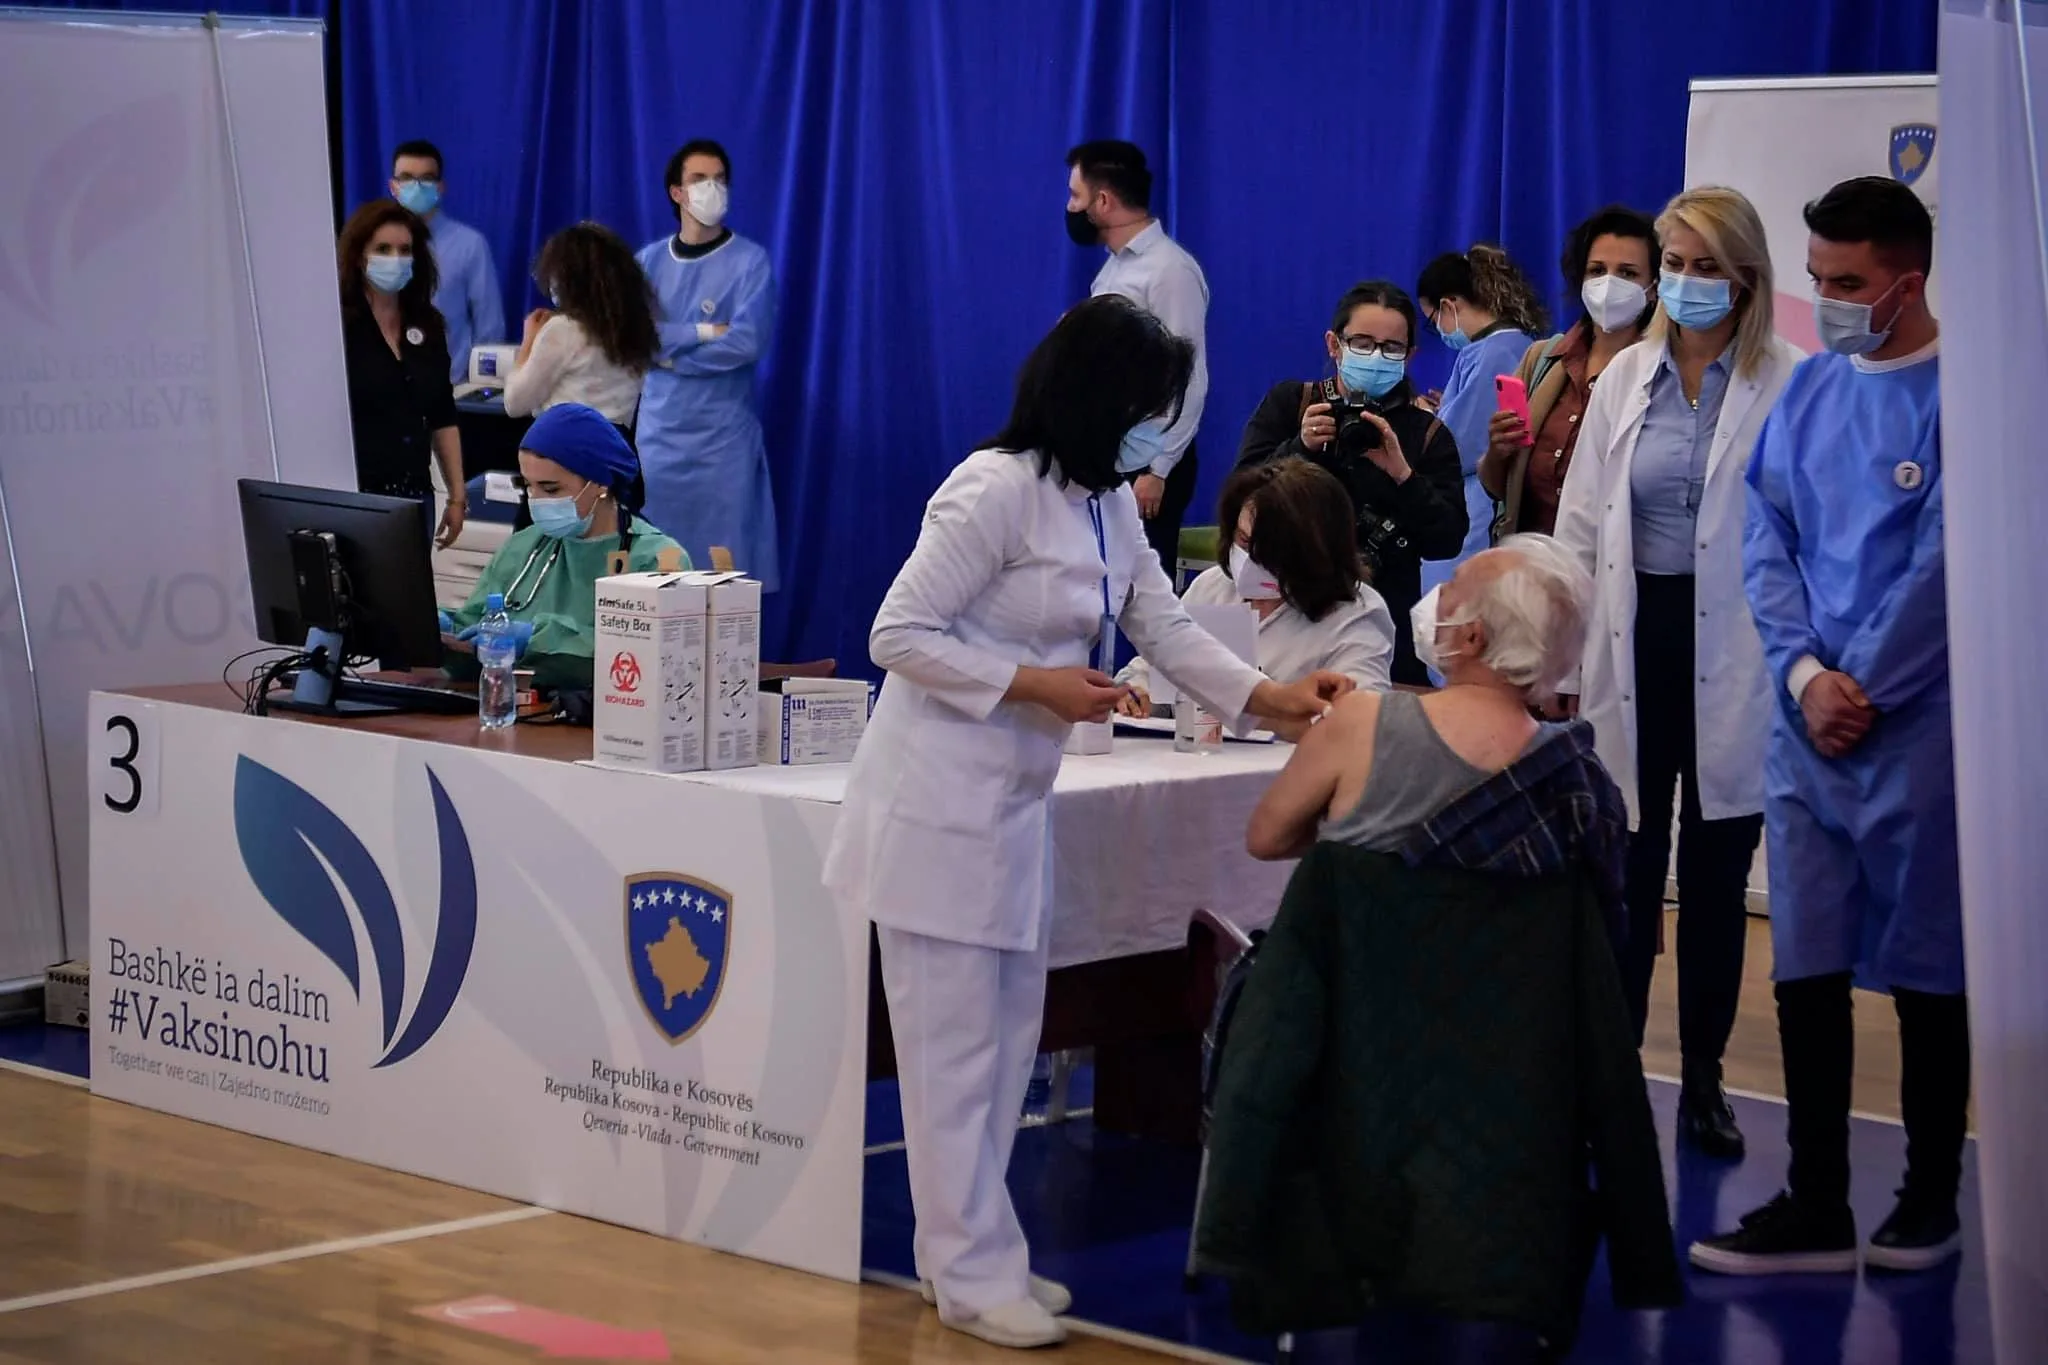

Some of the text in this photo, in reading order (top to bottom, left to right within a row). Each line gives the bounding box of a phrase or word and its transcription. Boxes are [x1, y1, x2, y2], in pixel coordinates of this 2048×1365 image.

[600, 615, 651, 632] Safety Box
[605, 695, 645, 707] BIOHAZARD
[104, 714, 143, 814] 3
[109, 938, 330, 1023] Bashkë ia dalim
[108, 987, 330, 1083] #Vaksinohu
[108, 1045, 162, 1075] Together
[165, 1063, 184, 1080] we
[187, 1068, 209, 1087] can
[218, 1072, 271, 1102] Zajedno
[272, 1088, 330, 1116] možemo
[544, 1076, 608, 1106] Republika
[612, 1092, 660, 1118] Kosova
[672, 1104, 731, 1135] Republic
[734, 1121, 749, 1137] of
[752, 1122, 804, 1150] Kosovo
[592, 1059, 753, 1112] Republika e Kosovës
[583, 1111, 629, 1136] Qeveria
[683, 1134, 760, 1166] Government
